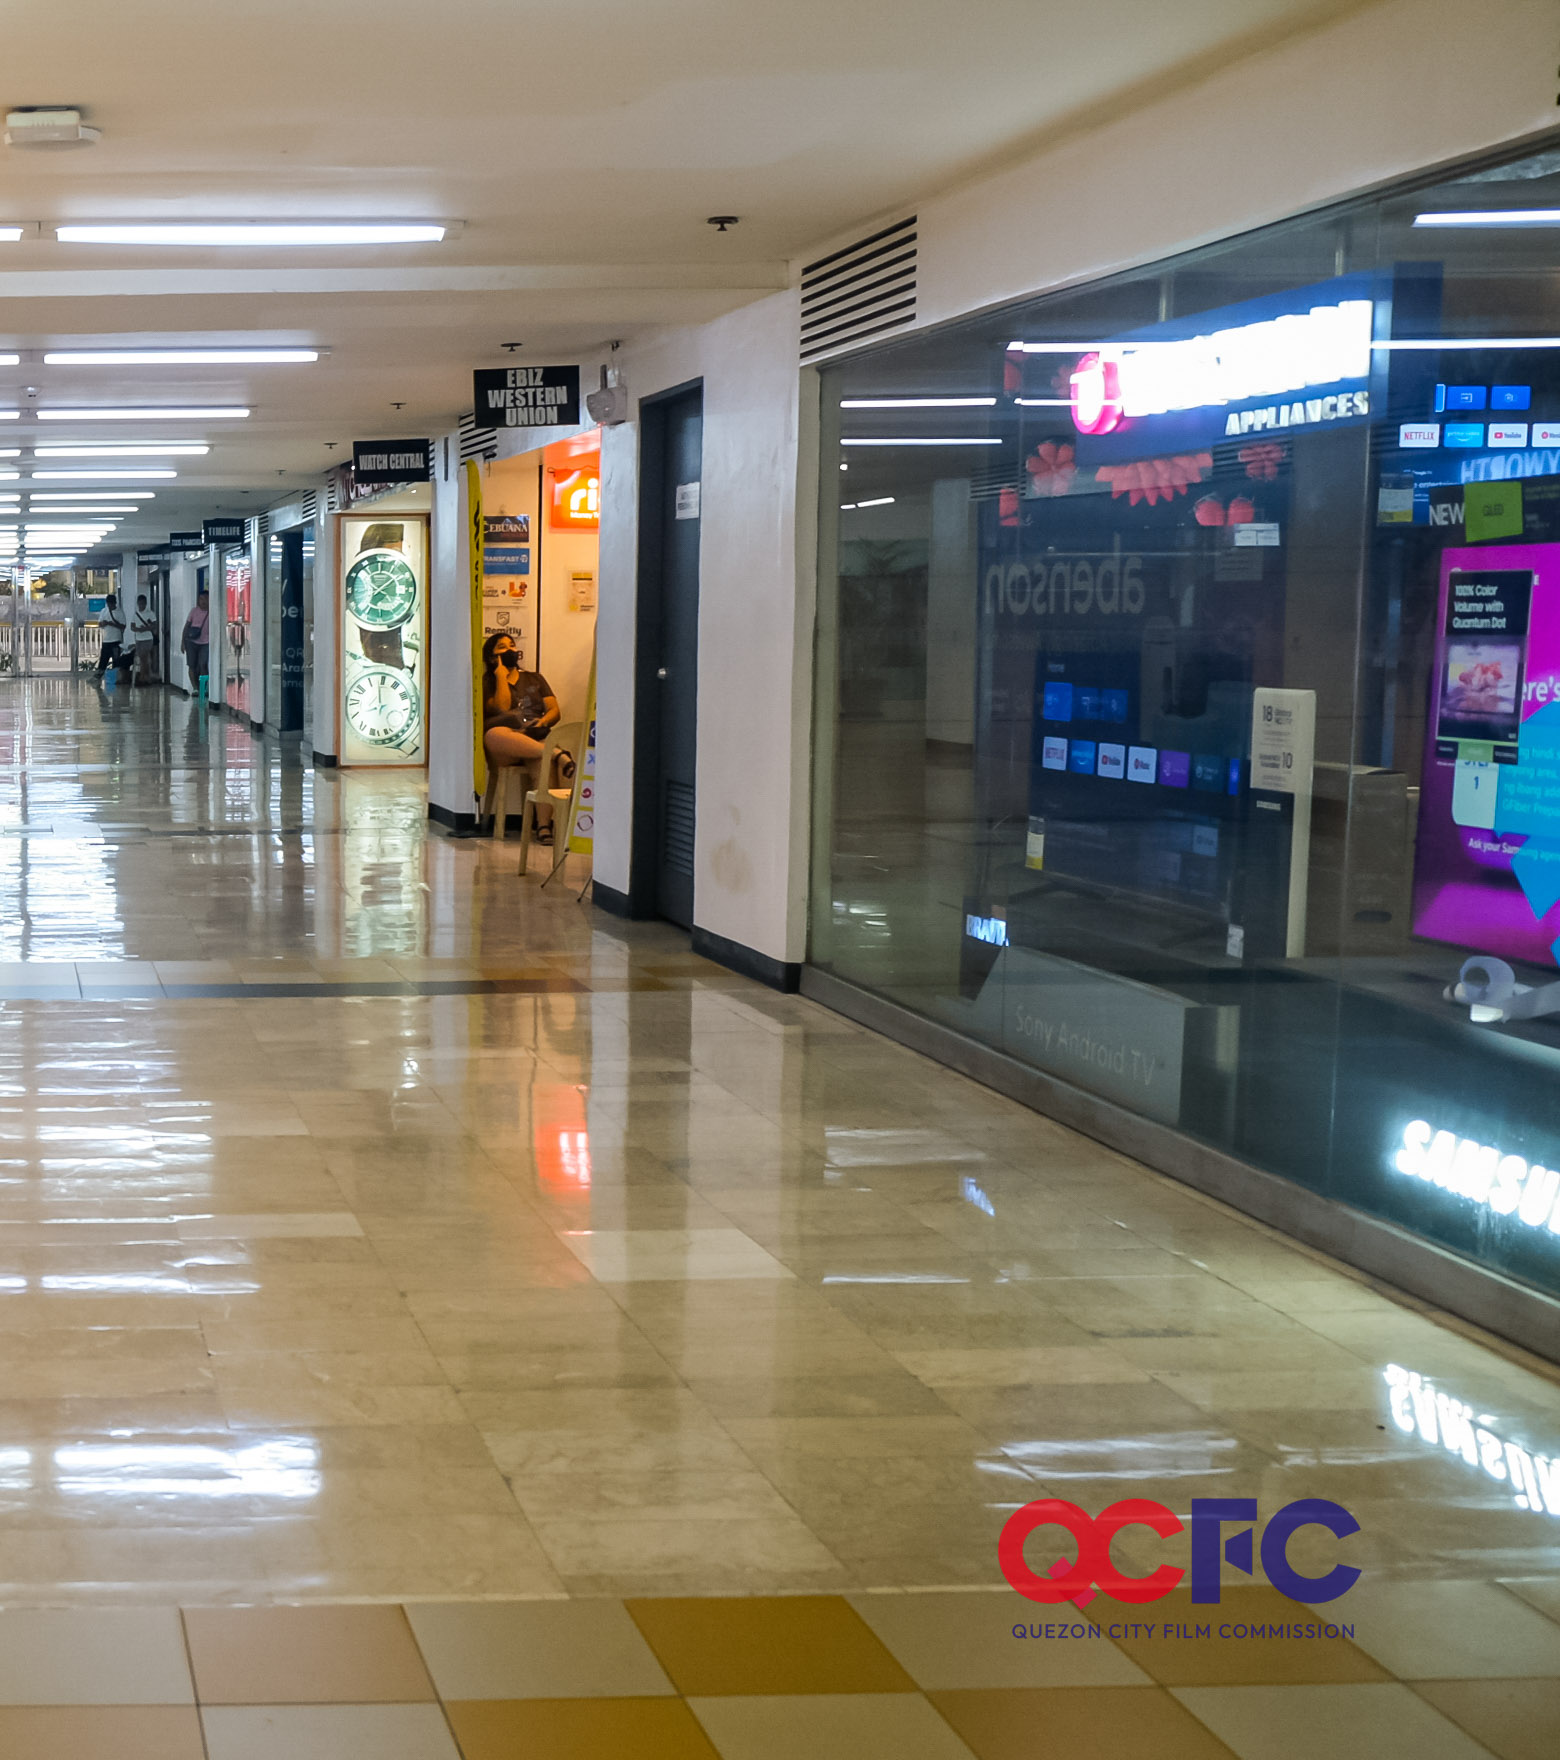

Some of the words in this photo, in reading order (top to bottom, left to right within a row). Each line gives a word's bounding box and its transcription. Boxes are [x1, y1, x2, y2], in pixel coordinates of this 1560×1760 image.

[507, 368, 544, 388] EBIZ
[487, 385, 568, 409] WESTERN
[505, 406, 558, 426] UNION
[1225, 391, 1369, 436] APPLIANCES
[1404, 431, 1434, 440] NETFLIX
[359, 454, 388, 470] WATCH
[389, 453, 425, 469] CENTRAL
[569, 478, 600, 511] ri
[1429, 502, 1467, 526] NEW
[208, 526, 241, 536] TIMELIFE
[1475, 585, 1498, 596] Color
[1454, 601, 1484, 612] Volume
[1485, 600, 1504, 612] with
[484, 625, 522, 637] Remitly
[1452, 617, 1490, 629] Quantum
[1492, 617, 1506, 629] Dot
[1474, 776, 1479, 790] 1
[1468, 837, 1482, 849] Ask
[1483, 842, 1501, 853] your
[1015, 1004, 1053, 1051] Sony
[1056, 1021, 1127, 1075] Android
[1130, 1048, 1156, 1086] TV
